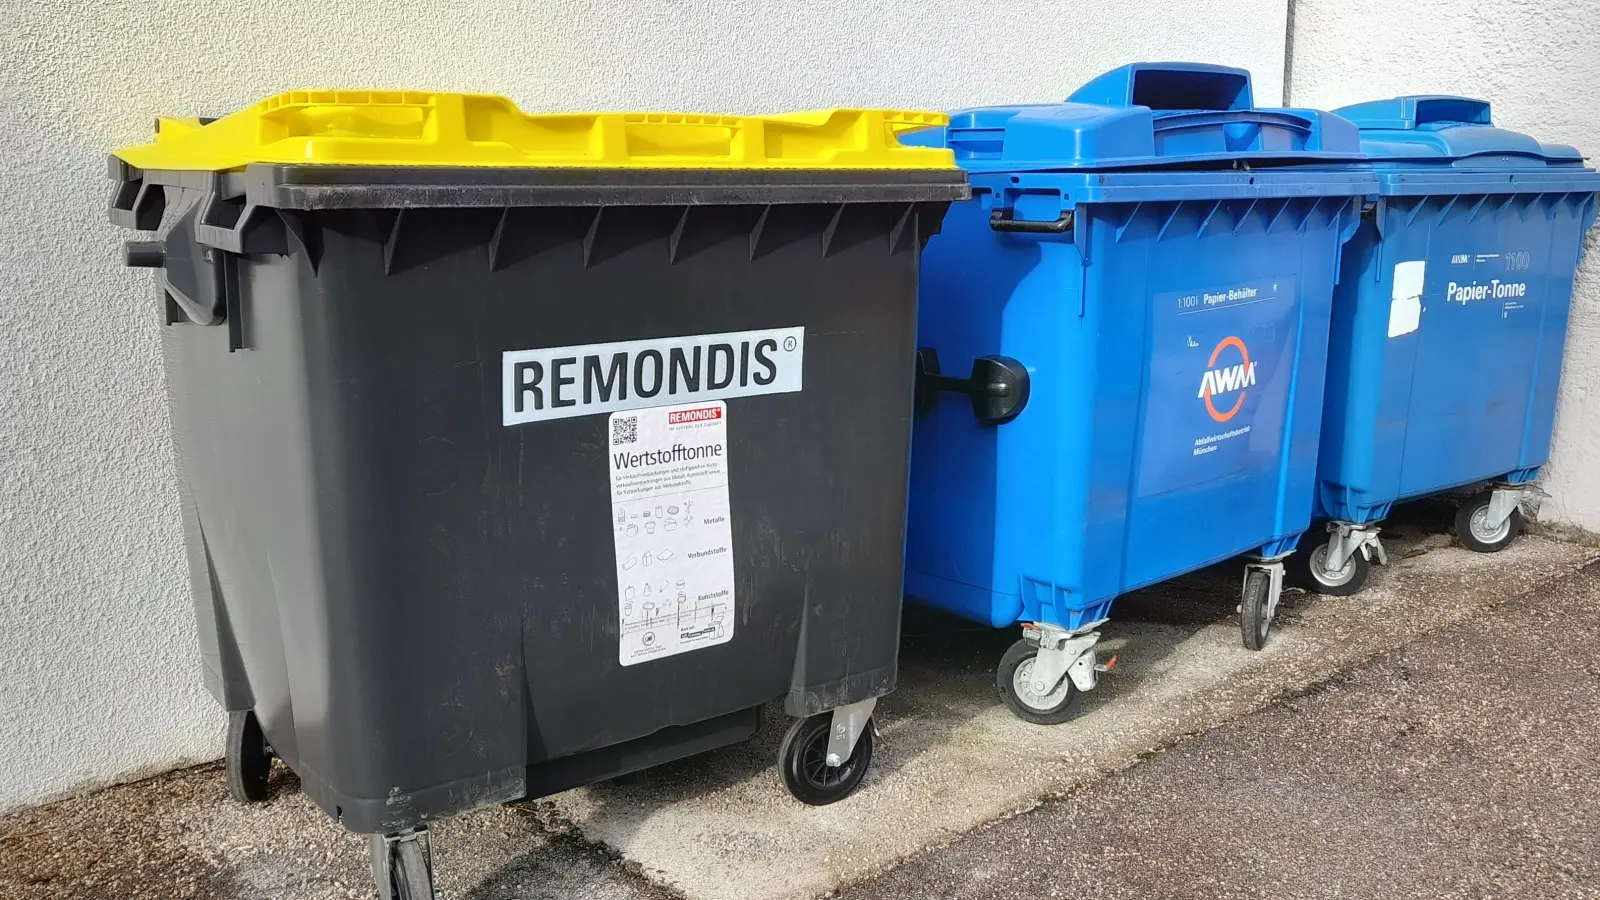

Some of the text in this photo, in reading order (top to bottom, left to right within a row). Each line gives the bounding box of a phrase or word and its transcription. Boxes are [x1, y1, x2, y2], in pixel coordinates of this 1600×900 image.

[1505, 251, 1530, 271] 1100
[1203, 287, 1258, 306] Papier-Behälter
[1447, 279, 1526, 305] Papier-Tonne
[1197, 361, 1256, 398] AWM
[1194, 425, 1251, 446] Abfallwirtschaftsbetrieb
[613, 444, 722, 470] Wertstofftonne
[1192, 444, 1218, 456] München
[703, 516, 725, 525] Metalle
[687, 546, 727, 559] Verbundstoffe
[697, 589, 729, 601] Kunststoffe
